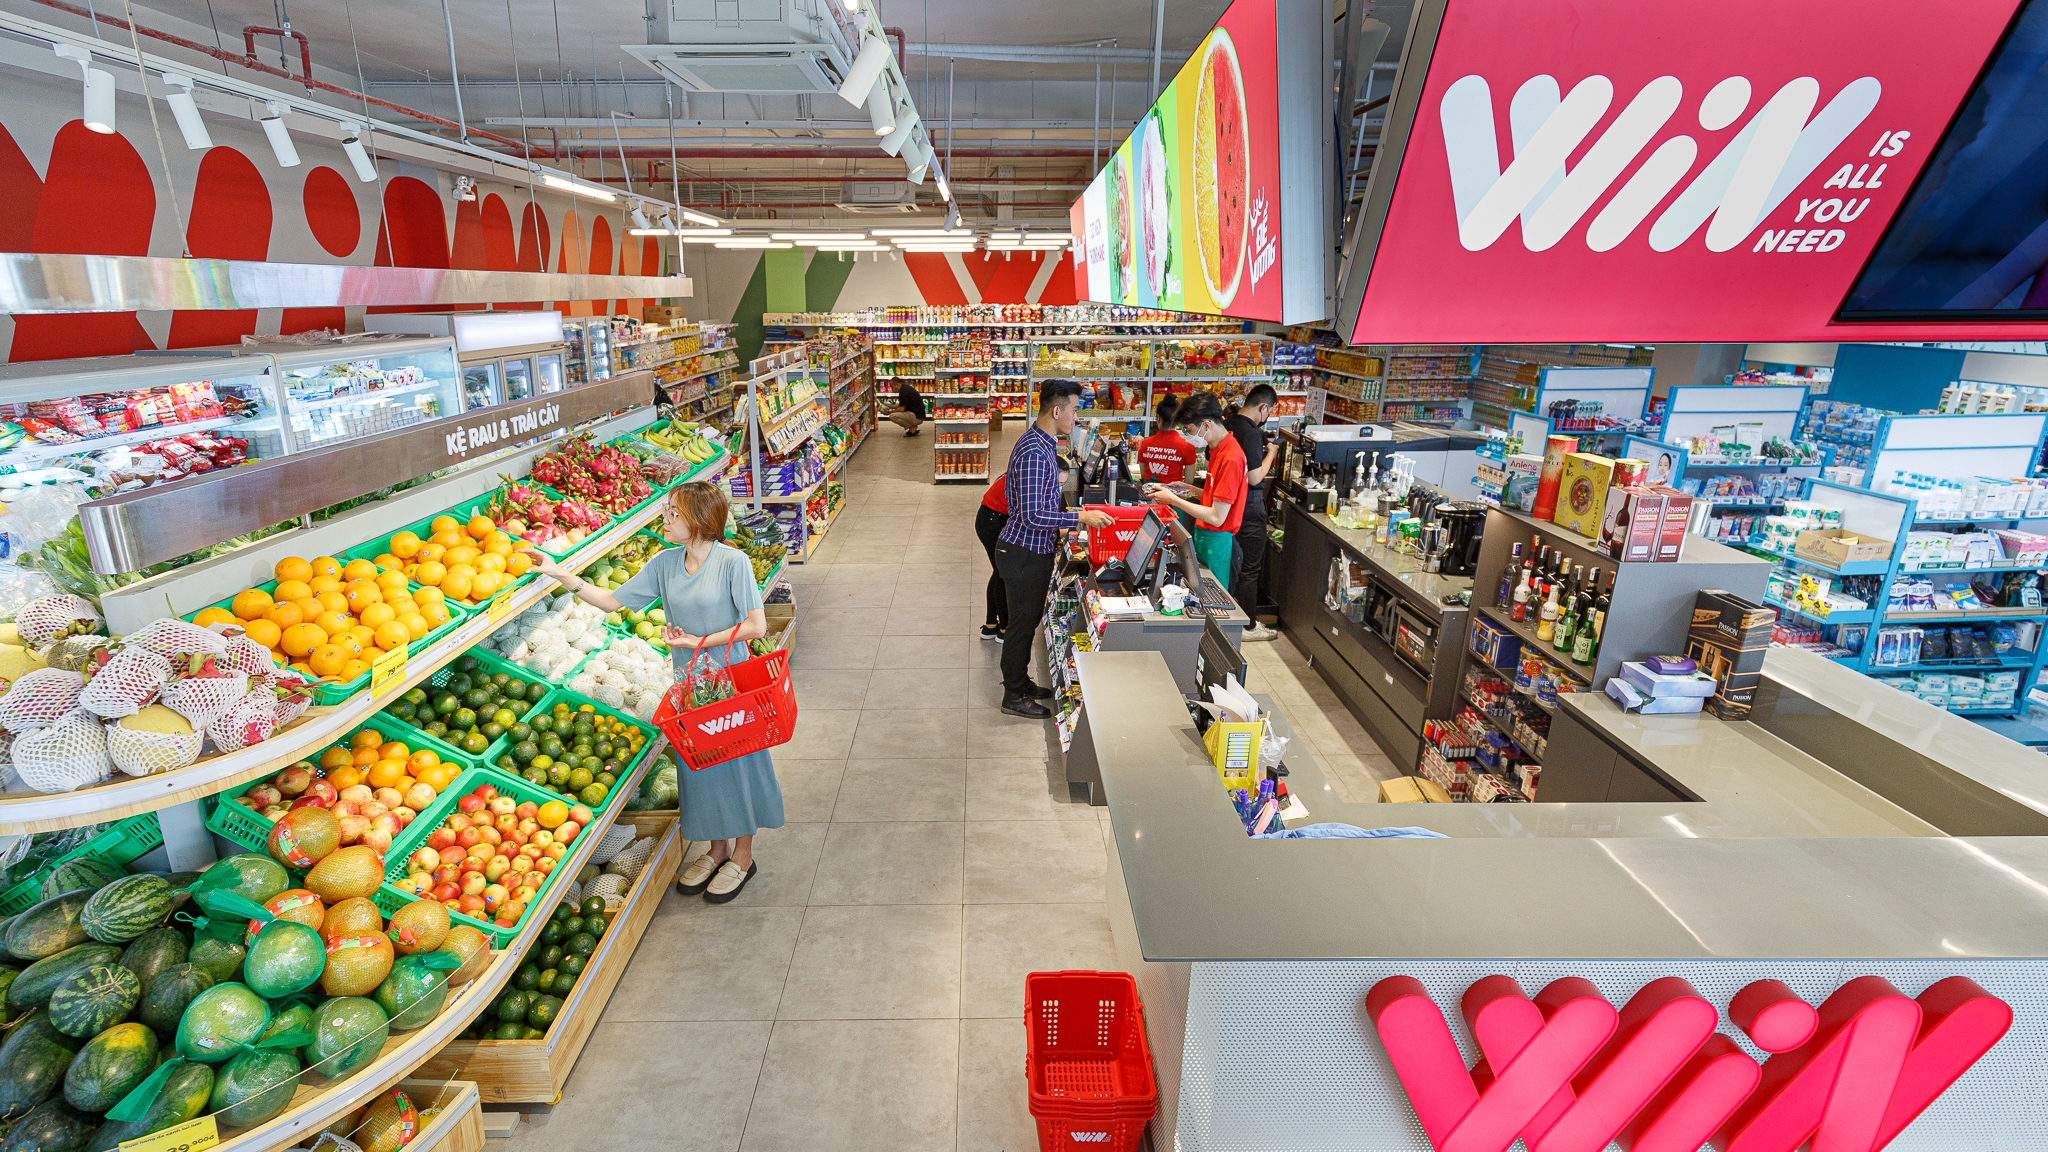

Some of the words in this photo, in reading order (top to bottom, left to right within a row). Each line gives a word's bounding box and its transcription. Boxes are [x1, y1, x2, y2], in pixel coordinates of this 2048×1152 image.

[1872, 130, 1911, 158] IS
[1823, 164, 1883, 190] ALL
[1794, 198, 1871, 223] YOU
[1752, 228, 1847, 253] NEED
[446, 425, 468, 457] KỆ
[468, 422, 499, 449] RAU
[499, 419, 511, 440] &
[509, 406, 539, 436] TRÁI
[538, 401, 560, 428] CÂY
[1717, 621, 1739, 637] PASSION
